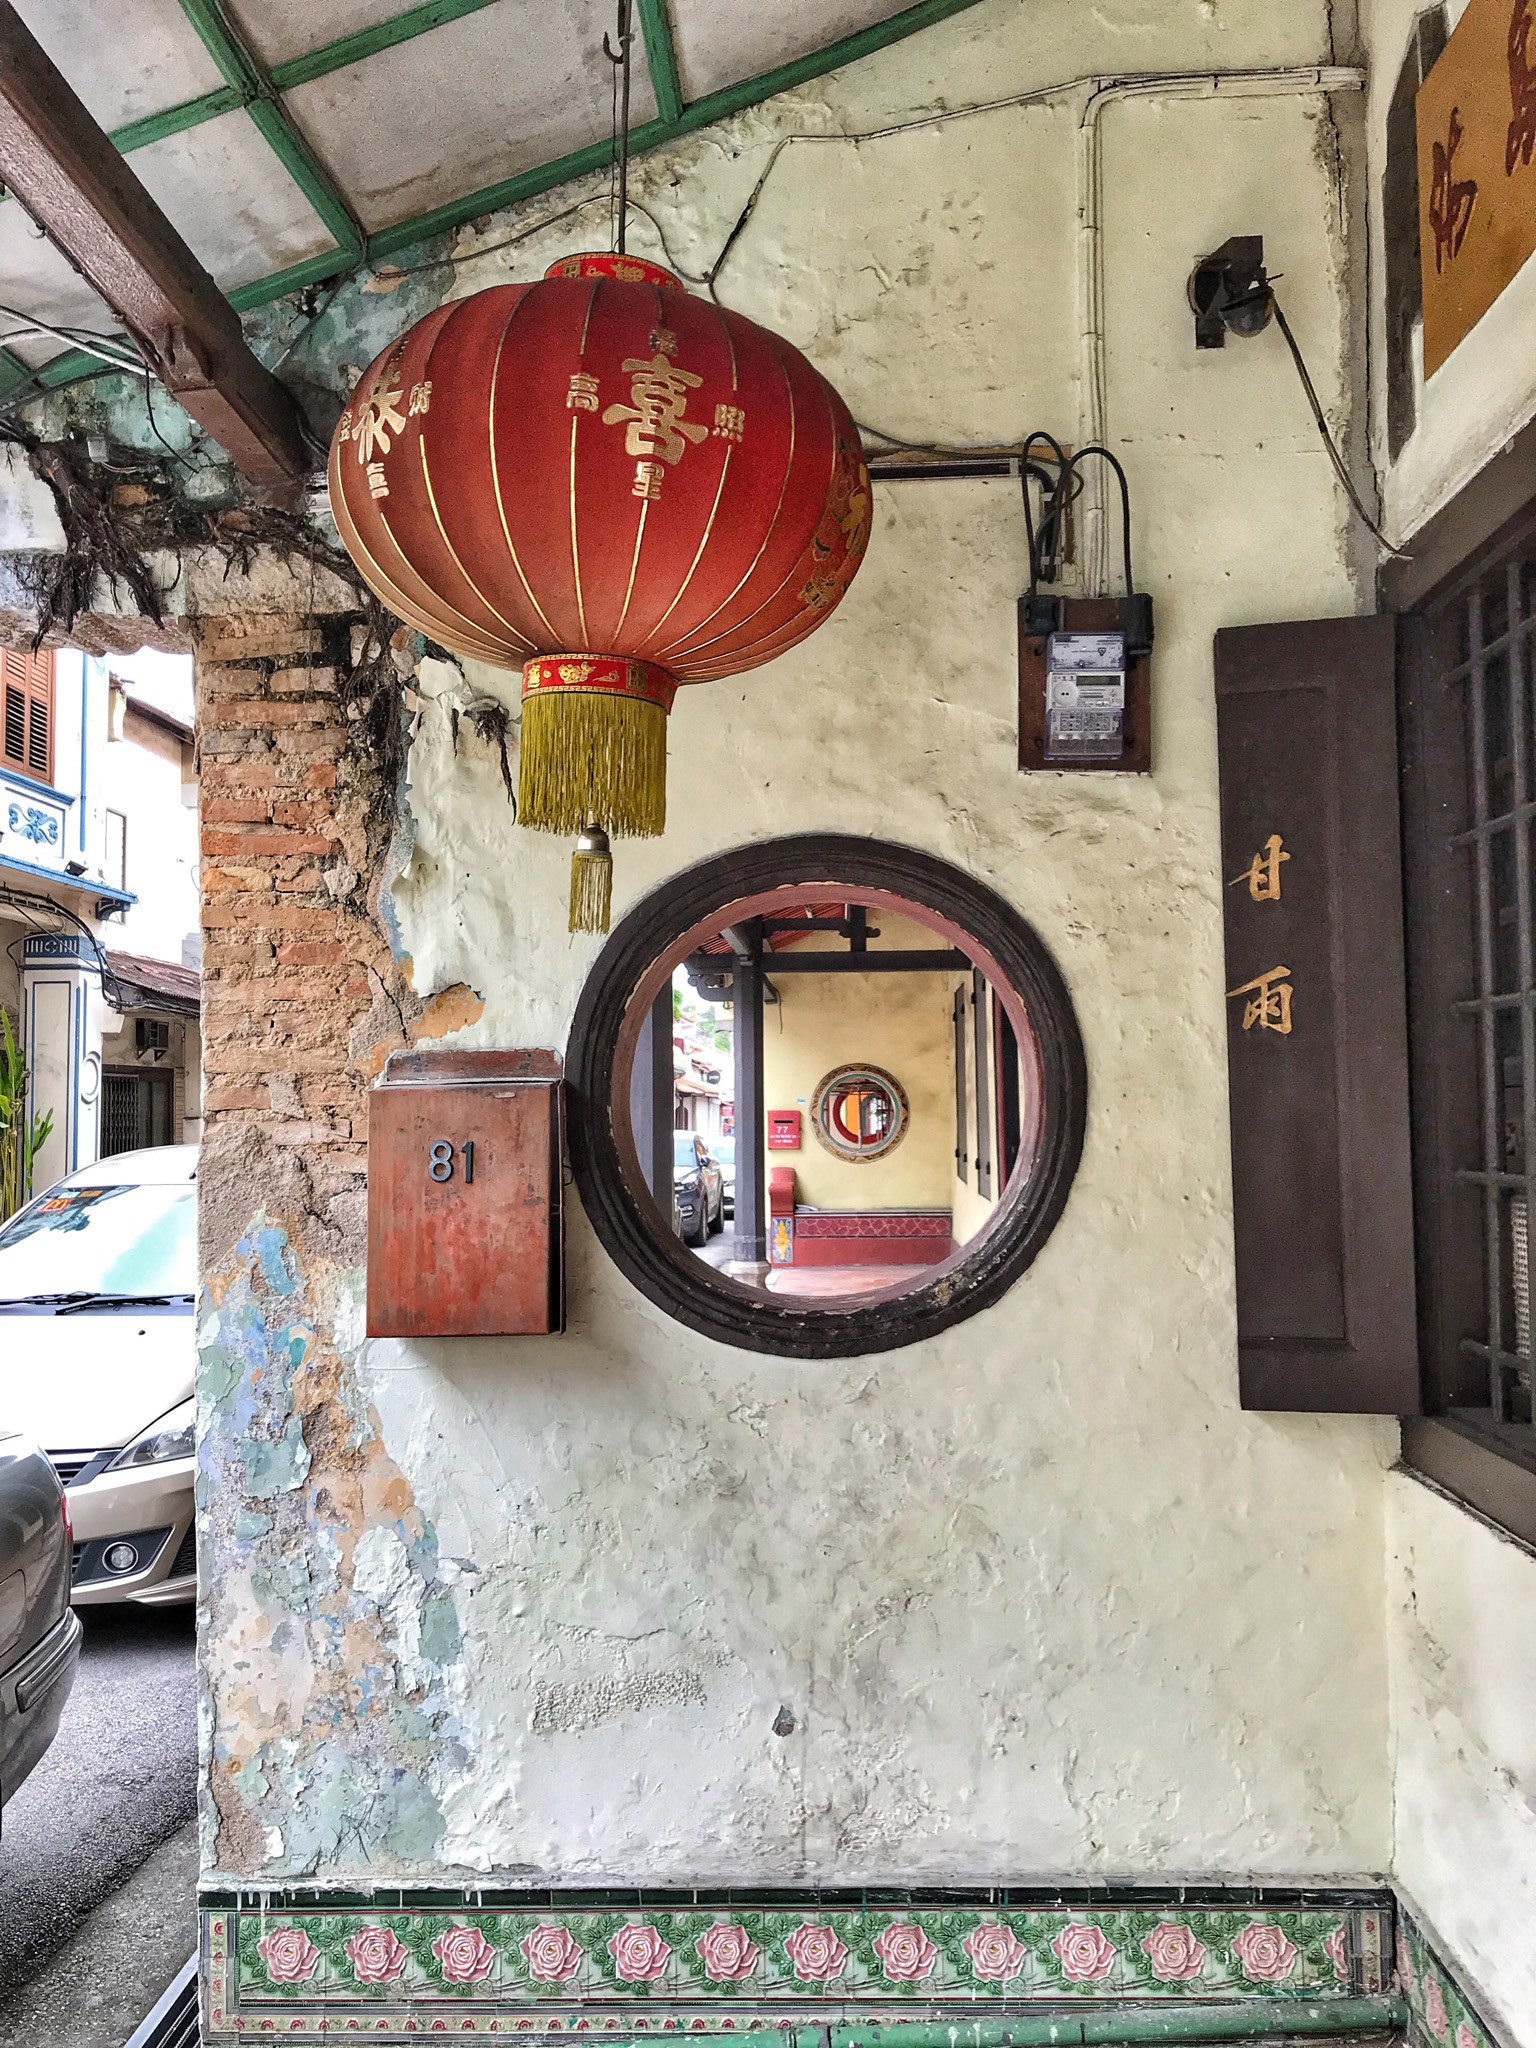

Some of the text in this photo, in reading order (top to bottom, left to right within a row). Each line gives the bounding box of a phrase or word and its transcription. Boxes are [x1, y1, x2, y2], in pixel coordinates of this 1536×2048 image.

[566, 373, 600, 412] 高
[602, 354, 709, 465] 喜
[712, 404, 746, 443] 照
[631, 461, 665, 499] 星
[776, 1126, 789, 1134] 77
[429, 1139, 474, 1184] 81
